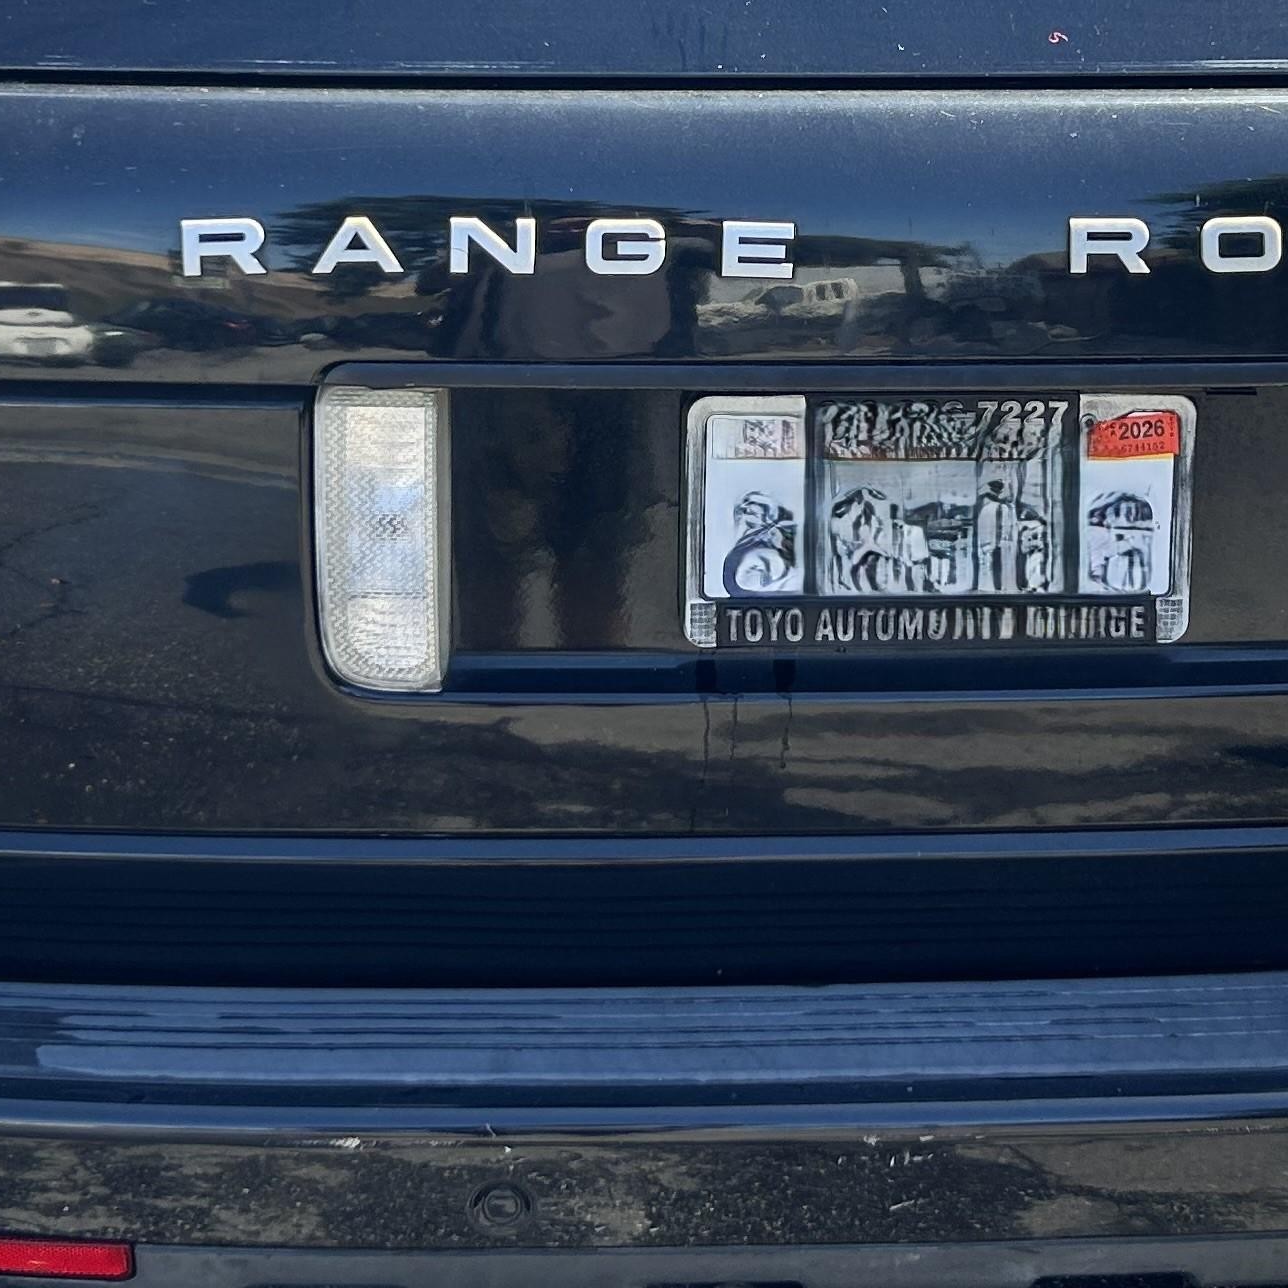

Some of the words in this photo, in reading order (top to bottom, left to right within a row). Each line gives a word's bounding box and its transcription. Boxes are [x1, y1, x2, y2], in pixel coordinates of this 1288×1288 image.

[179, 216, 796, 280] RANGE
[1067, 216, 1283, 276] RO
[1119, 419, 1165, 440] 2026
[726, 608, 804, 642] TOYO
